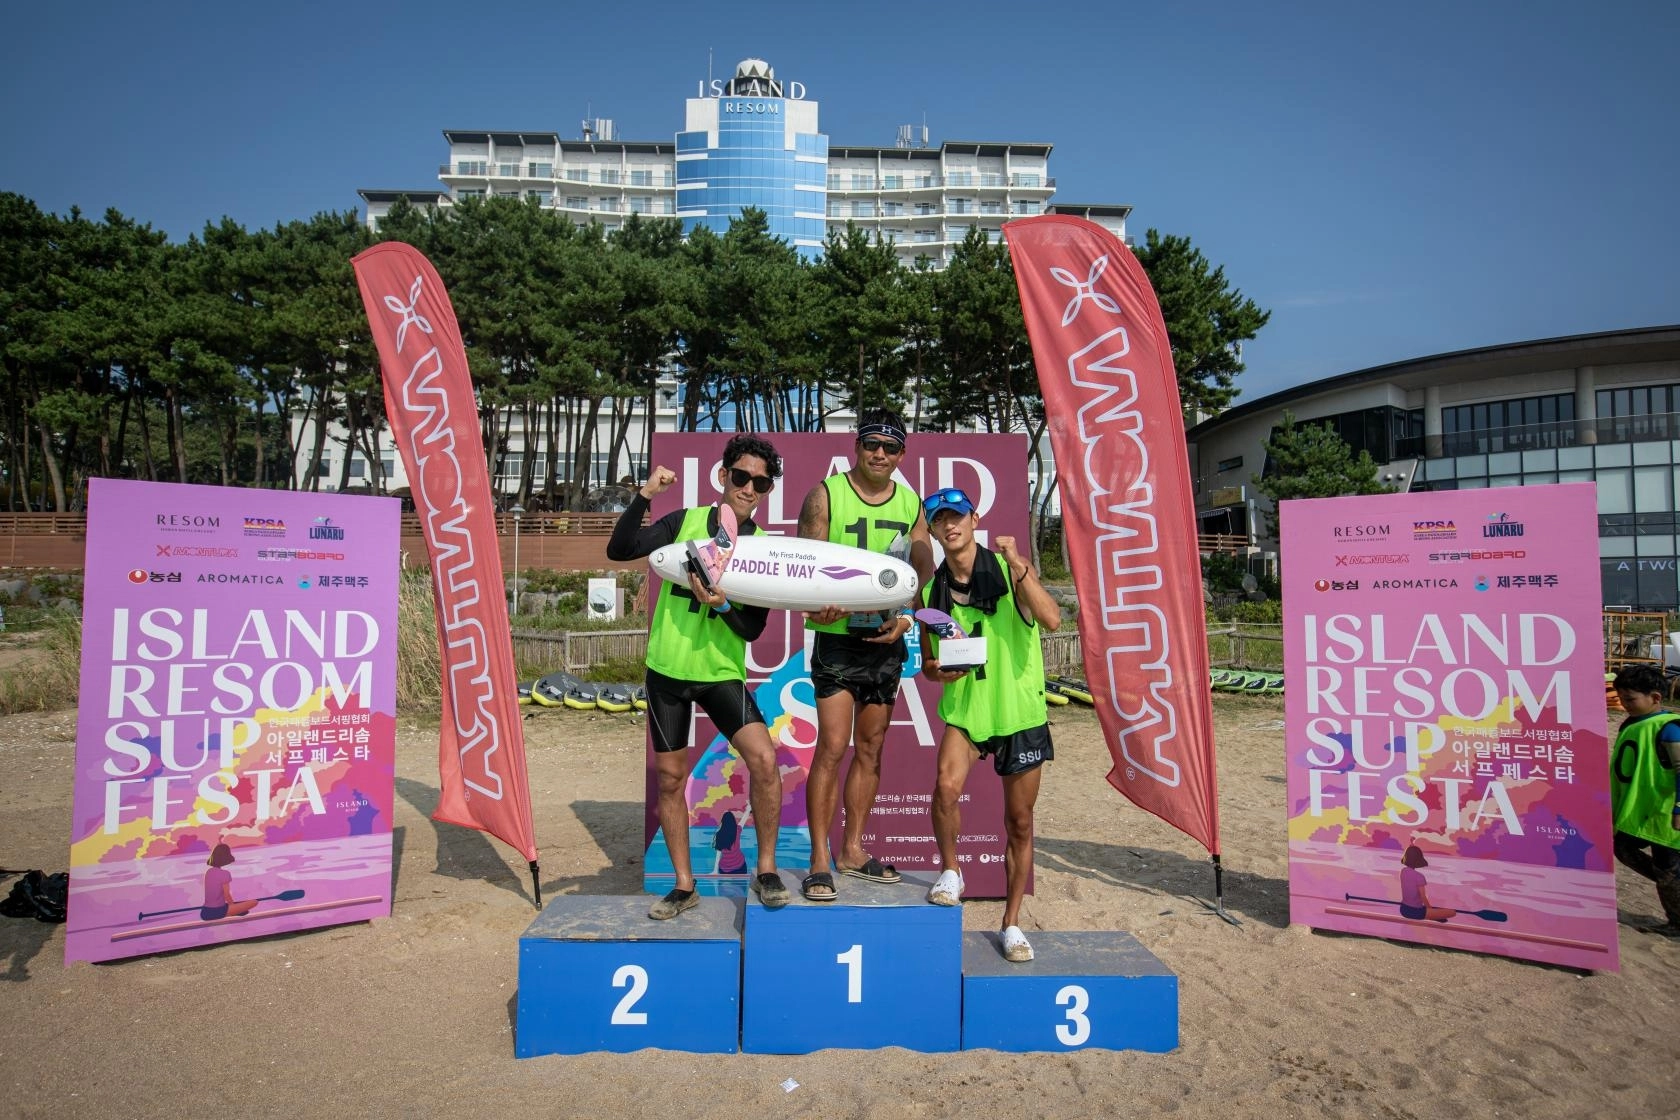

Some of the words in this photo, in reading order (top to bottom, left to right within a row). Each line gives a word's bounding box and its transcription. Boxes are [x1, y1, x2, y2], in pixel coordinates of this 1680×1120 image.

[699, 79, 806, 100] ISLAND
[726, 102, 778, 114] RESOM
[157, 514, 220, 528] RESOM
[243, 517, 286, 530] KPSA
[1413, 520, 1457, 532] KPSA
[309, 527, 344, 541] LUNARU
[1334, 524, 1391, 537] RESOM
[1483, 524, 1524, 538] LUNARU
[769, 550, 779, 559] My
[781, 551, 794, 559] First
[795, 553, 817, 561] Paddle
[731, 558, 780, 576] PADDLE
[786, 563, 816, 579] WAY
[1617, 560, 1630, 571] A
[149, 571, 182, 584] 농심
[197, 573, 284, 585] AROMATICA
[318, 575, 369, 588] 제주맥주
[1373, 578, 1458, 589] AROMATICA
[1497, 574, 1559, 588] 제주맥주
[1331, 580, 1359, 591] 농심
[111, 607, 380, 661] ISLAND
[946, 621, 958, 639] 3
[1304, 613, 1577, 666] ISLAND
[107, 661, 373, 719] RESOM
[1306, 666, 1573, 725] RESOM
[266, 727, 371, 748] 아일랜드리솜
[1306, 717, 1447, 773] SUP
[103, 716, 262, 776] SUP
[1452, 740, 1575, 764] 아일랜드리솜
[1019, 748, 1041, 764] SSU
[103, 766, 327, 836] FESTA
[336, 799, 368, 809] ISLAND
[1307, 769, 1525, 837] FESTA
[1536, 825, 1577, 836] ISLAND
[836, 944, 863, 1003] 1
[610, 964, 649, 1025] 2
[1055, 985, 1091, 1046] 3
